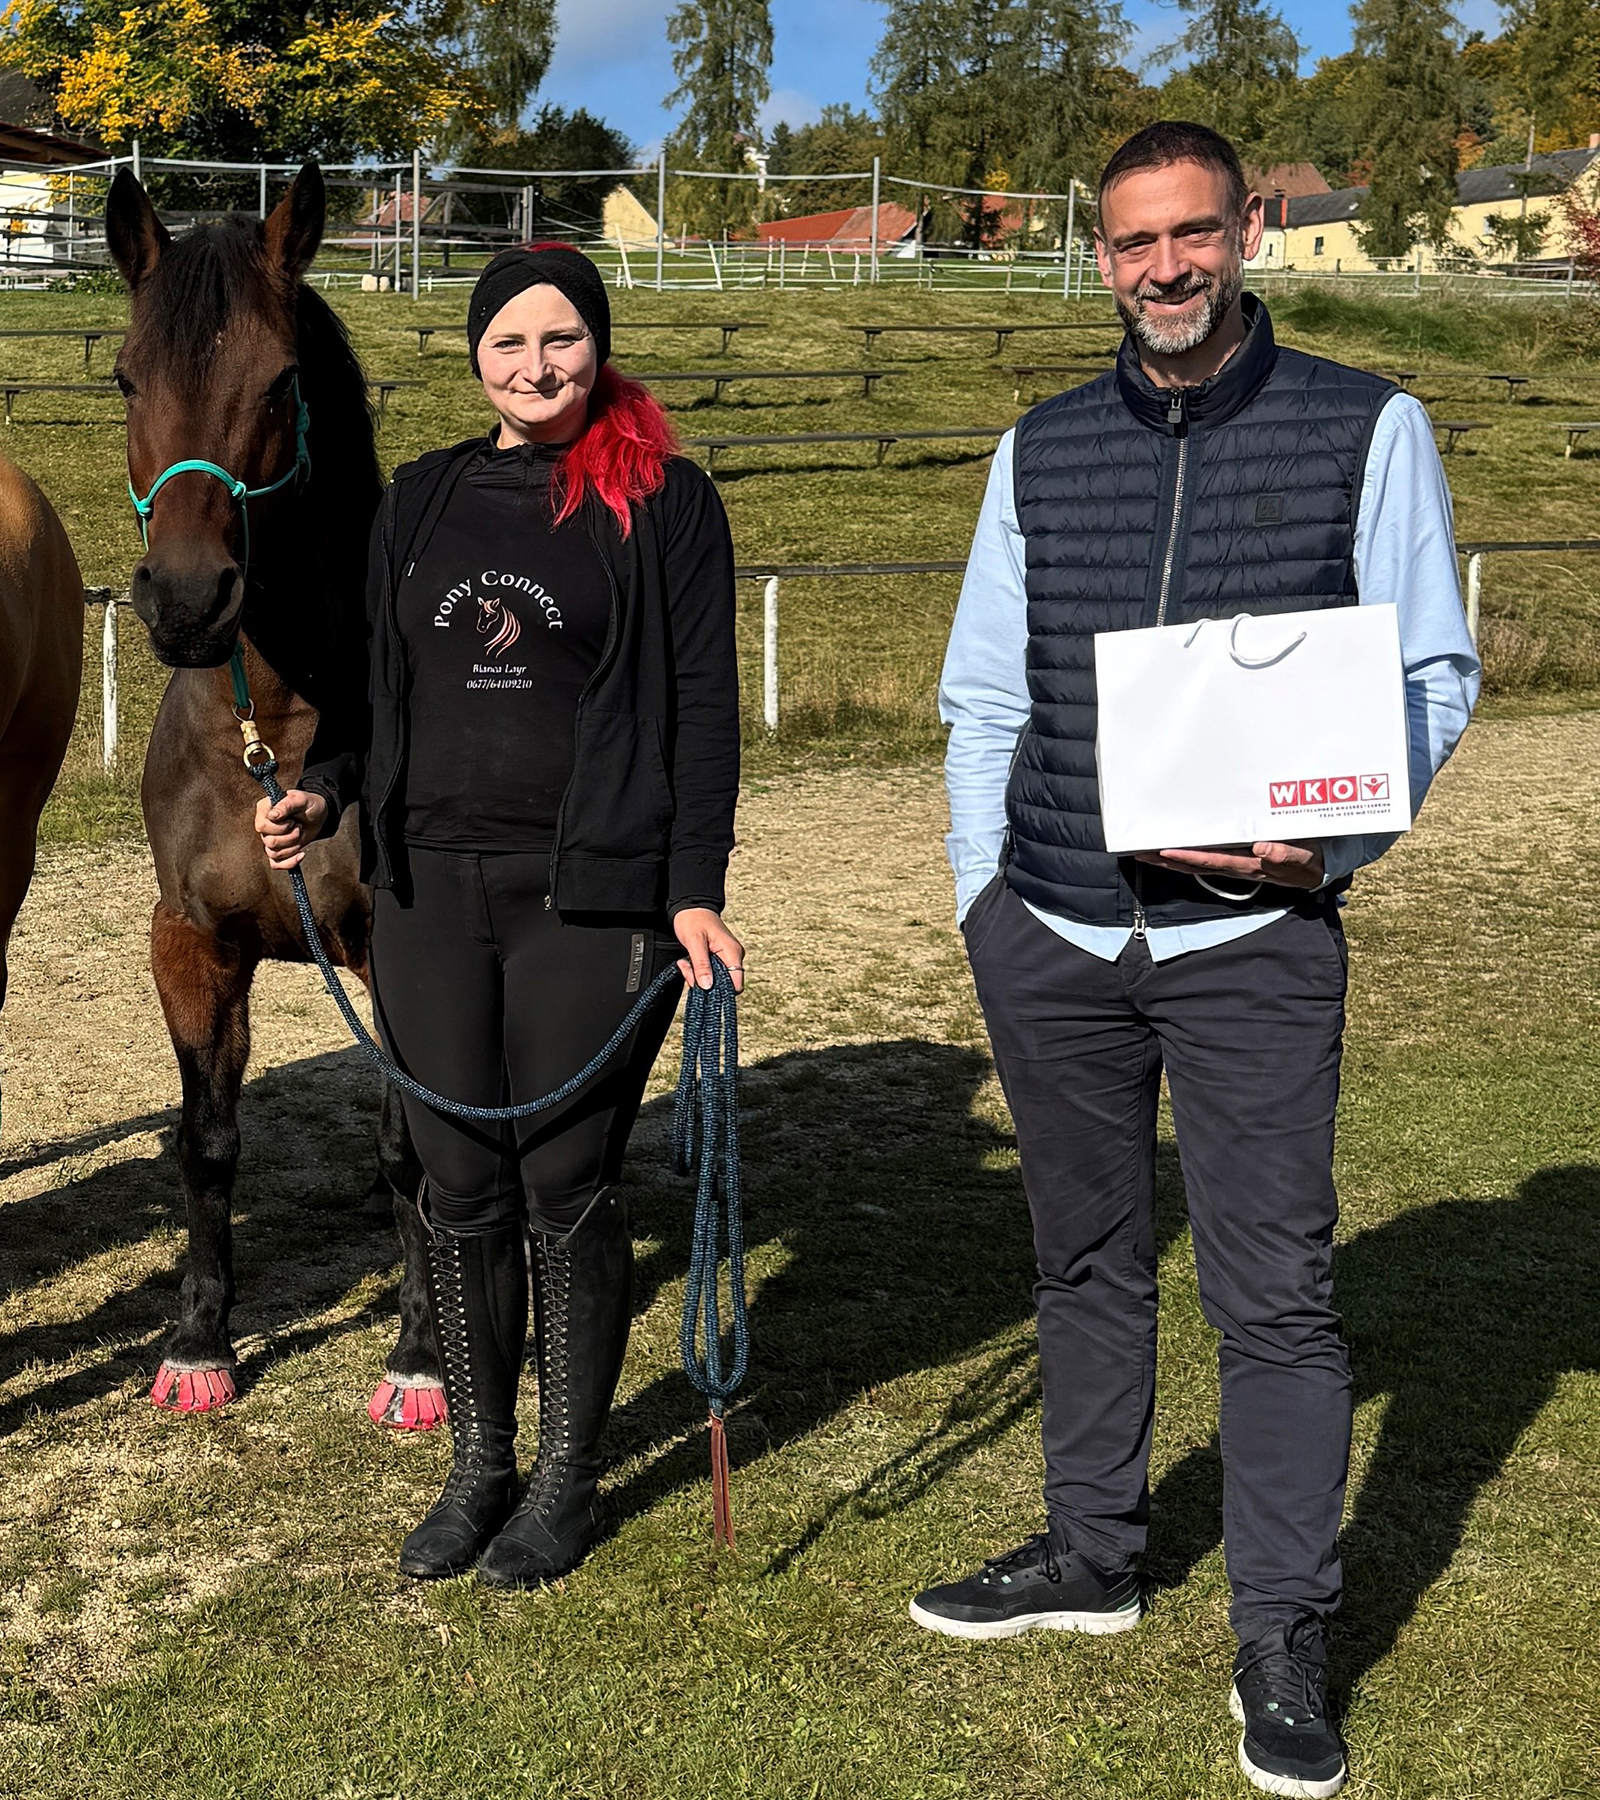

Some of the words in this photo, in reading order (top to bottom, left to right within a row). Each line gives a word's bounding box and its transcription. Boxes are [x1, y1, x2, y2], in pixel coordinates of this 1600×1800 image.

[434, 578, 472, 628] Pony
[481, 570, 563, 629] Connect
[466, 678, 533, 690] 0677/64109210
[1270, 778, 1357, 806] WKO
